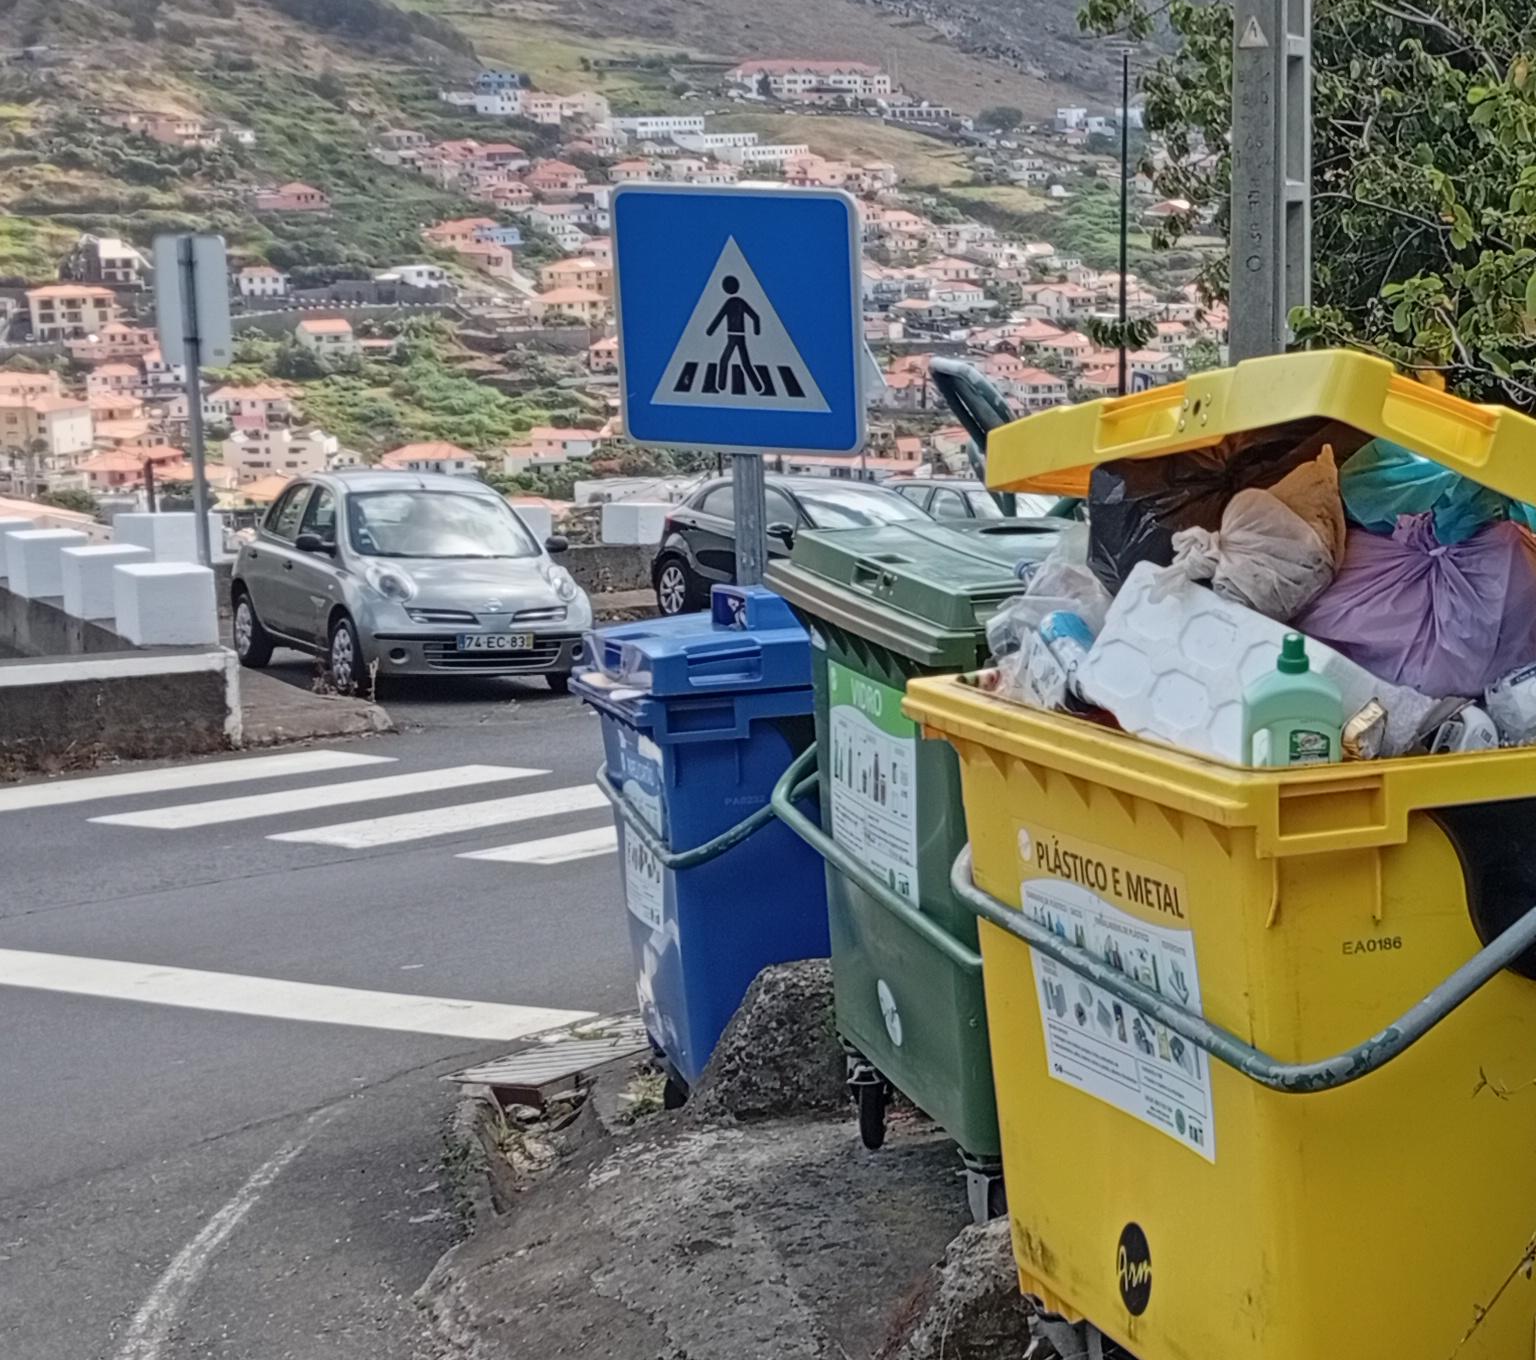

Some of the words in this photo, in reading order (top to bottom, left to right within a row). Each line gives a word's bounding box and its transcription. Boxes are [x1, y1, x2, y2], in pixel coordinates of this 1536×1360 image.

[850, 677, 882, 717] VIDRO
[1036, 839, 1108, 892] PLÁSTICO
[1111, 866, 1123, 897] E
[1126, 870, 1185, 919] METAL
[1342, 936, 1402, 955] EA0186
